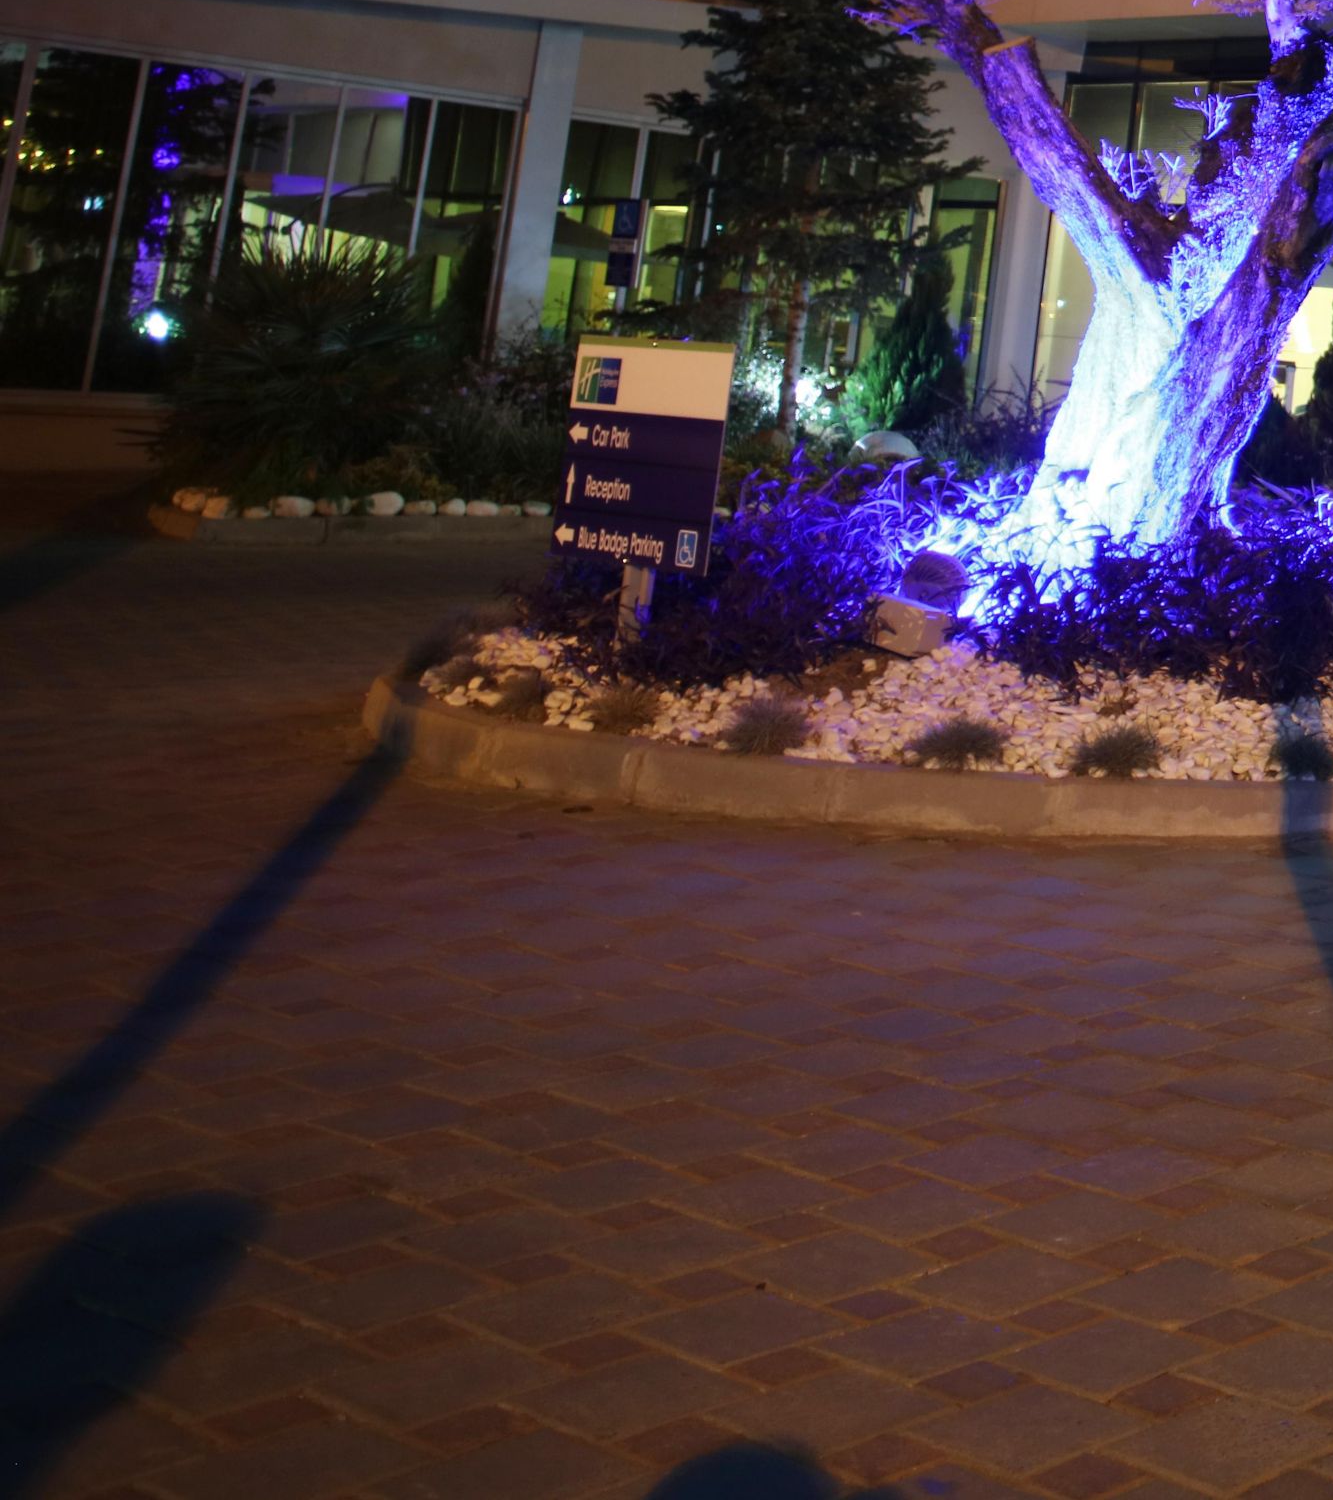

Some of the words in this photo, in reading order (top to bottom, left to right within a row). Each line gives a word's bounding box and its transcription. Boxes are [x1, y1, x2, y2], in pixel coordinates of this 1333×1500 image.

[592, 424, 609, 447] Car
[610, 426, 630, 449] Park
[585, 474, 630, 504] Reception
[578, 526, 597, 550] Blue
[598, 528, 628, 559] Badge
[630, 532, 664, 565] Parking
